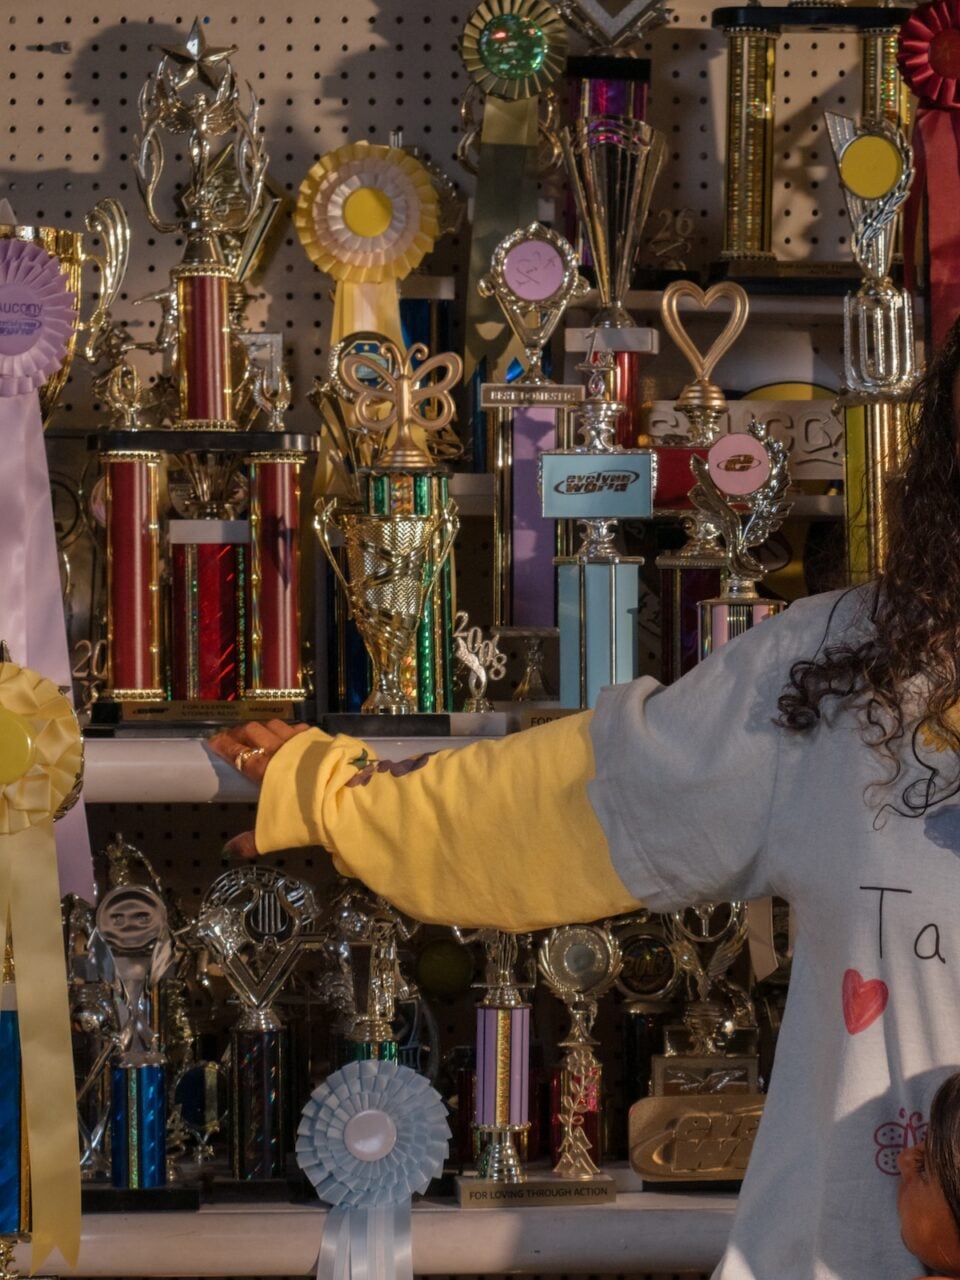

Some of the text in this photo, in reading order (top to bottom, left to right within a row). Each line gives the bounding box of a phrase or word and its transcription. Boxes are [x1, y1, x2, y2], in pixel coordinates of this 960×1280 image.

[490, 391, 577, 401] BEST DOMESTIC
[469, 1187, 608, 1200] FOR LOVING THROUGH ACTION
